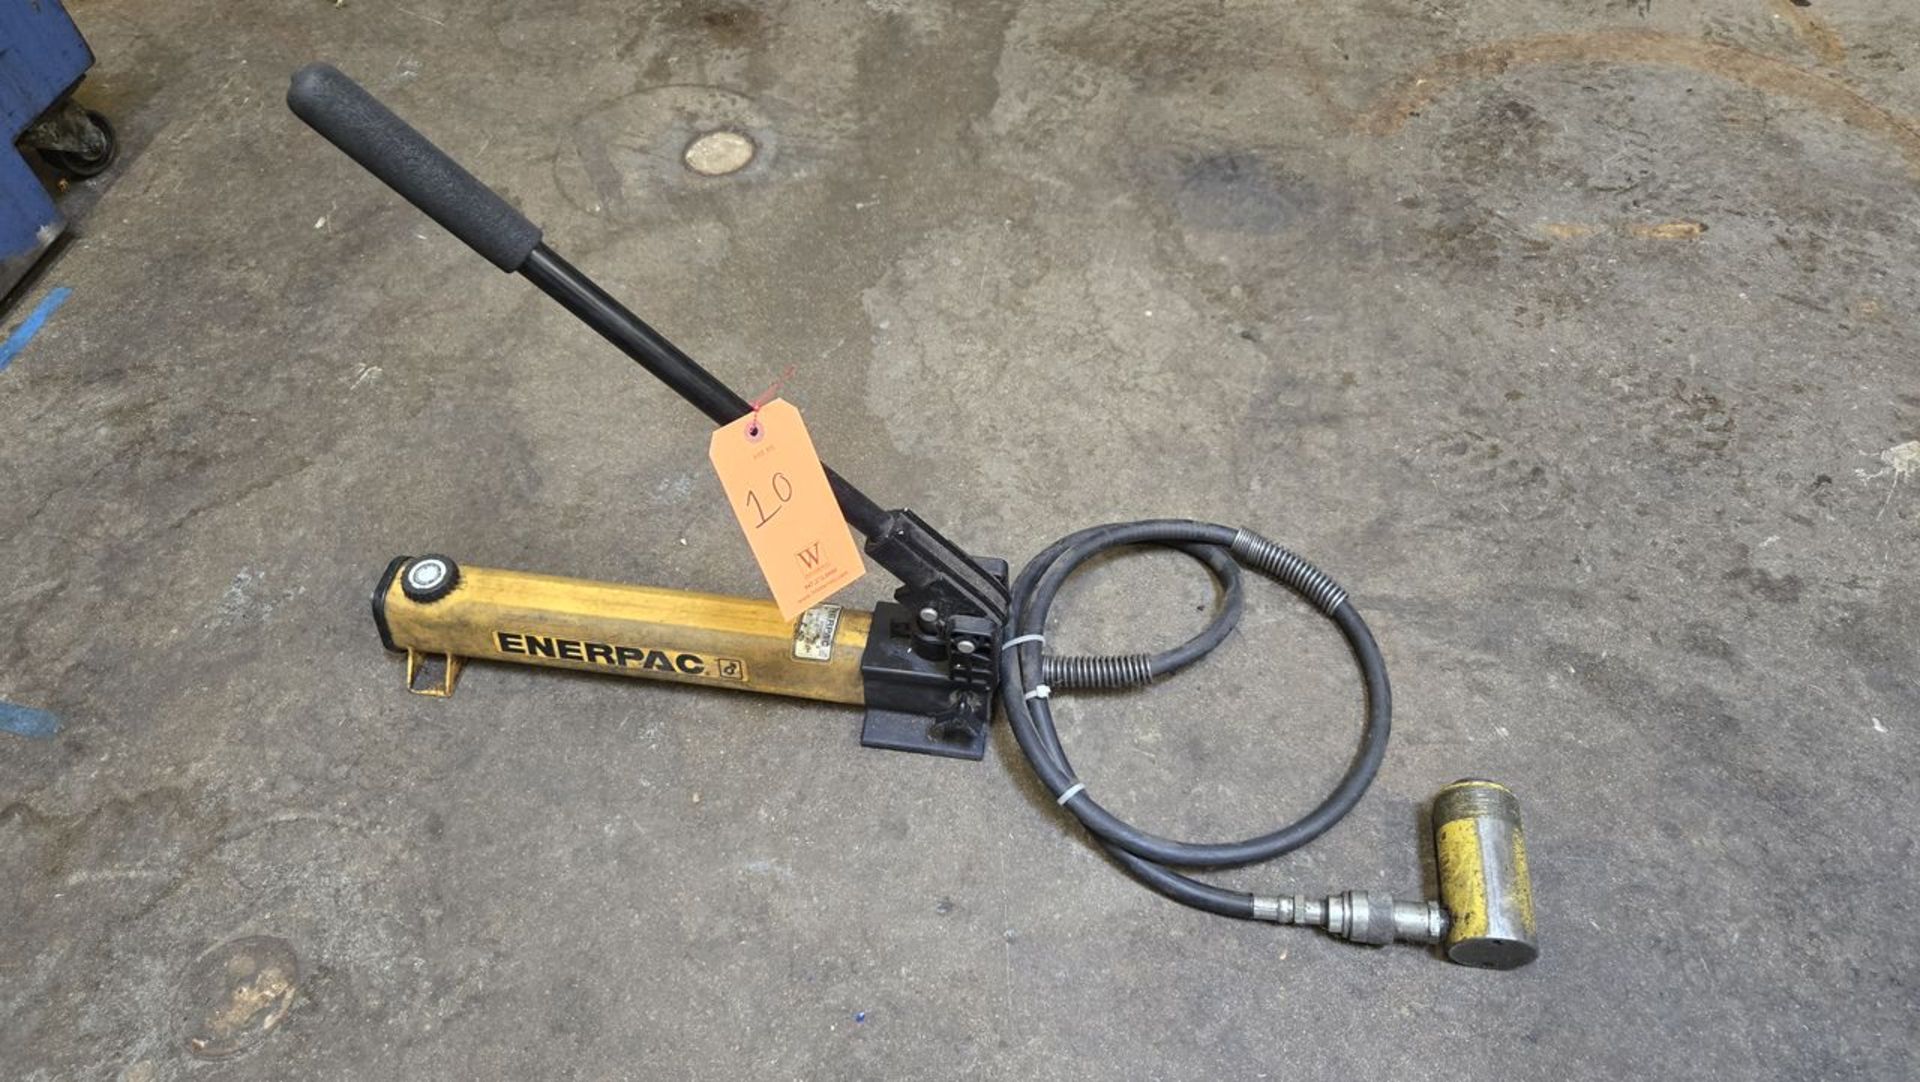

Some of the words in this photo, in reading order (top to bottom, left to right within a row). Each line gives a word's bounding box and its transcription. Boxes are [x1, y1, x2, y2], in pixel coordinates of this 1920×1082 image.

[746, 472, 793, 529] 10
[797, 541, 820, 569] W
[497, 631, 705, 675] ENERPAC
